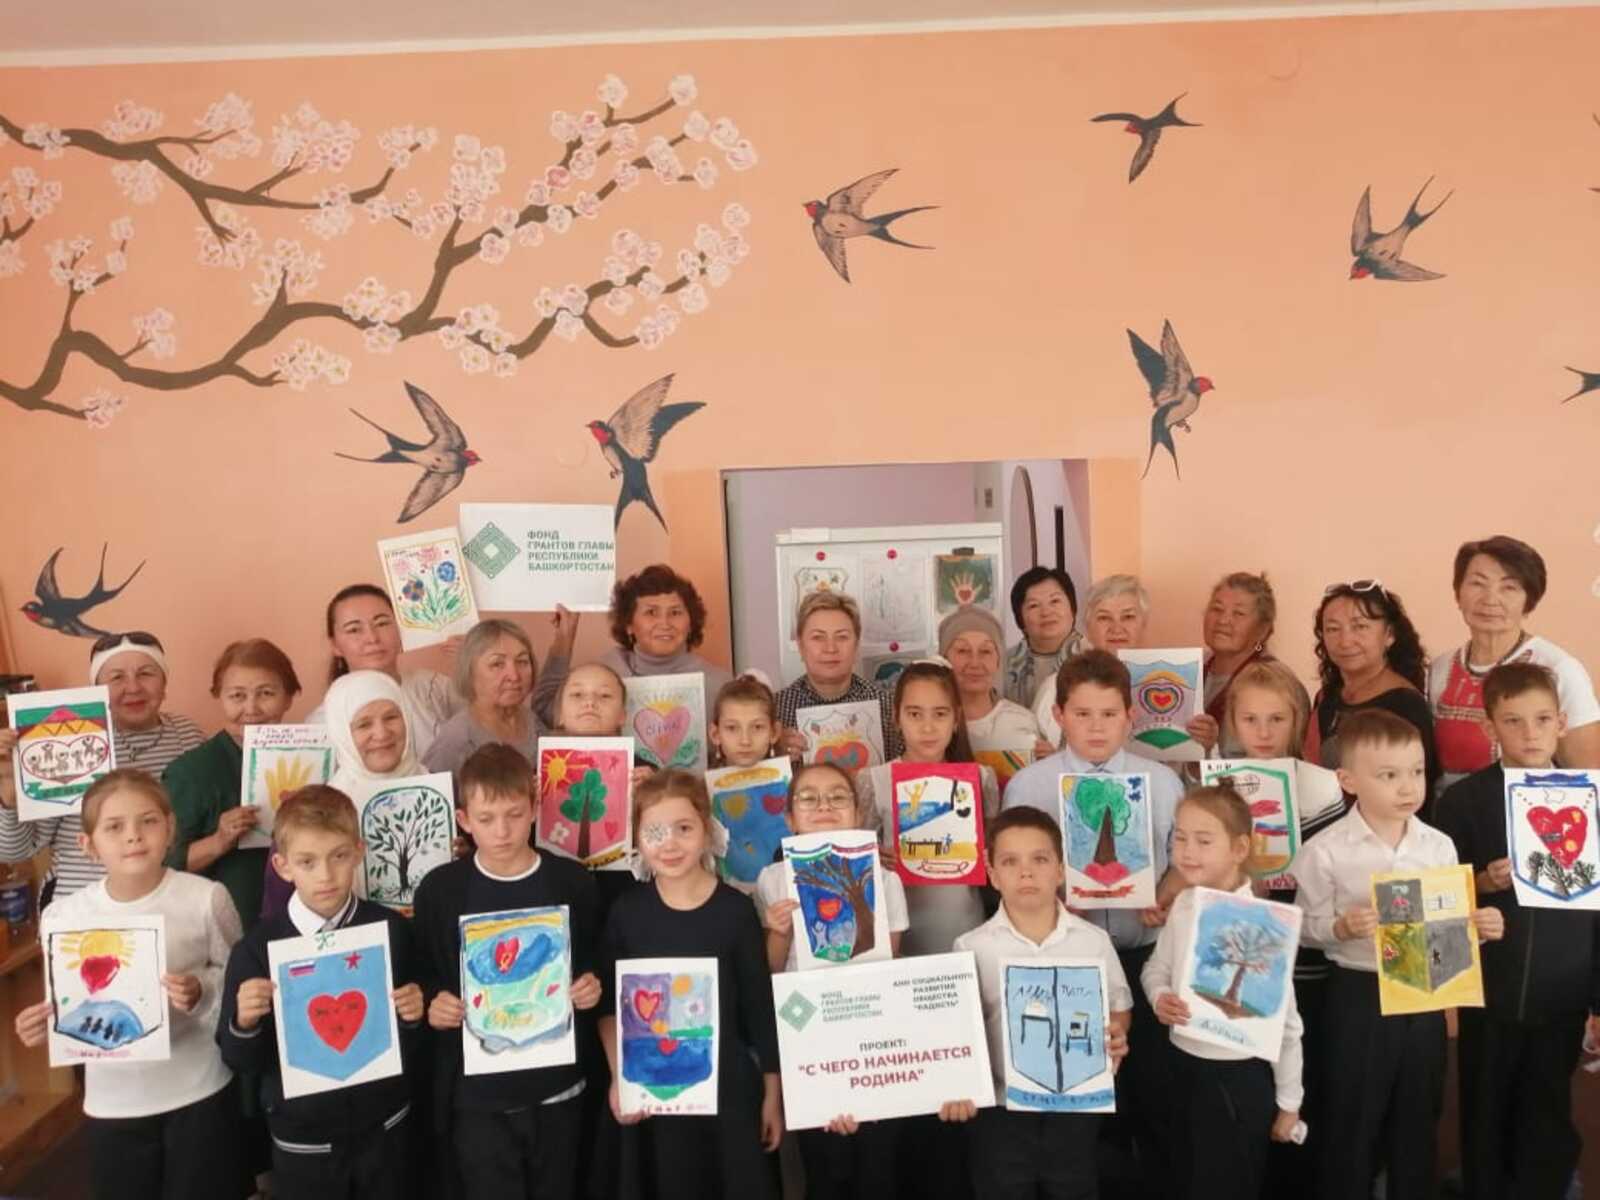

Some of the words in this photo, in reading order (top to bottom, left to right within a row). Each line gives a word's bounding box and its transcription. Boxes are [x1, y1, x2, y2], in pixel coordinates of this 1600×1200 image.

[527, 530, 560, 540] ФОНД
[527, 541, 575, 550] ГРАНТОВ
[578, 541, 615, 550] ГЛАВЫ
[528, 551, 599, 561] РЕСПУБЛИКИ
[528, 562, 615, 571] БАШКОРТОСТАН
[913, 983, 956, 993] РАЗВИТИЯ
[913, 992, 958, 1002] ОБЩЕСТВА
[859, 1038, 907, 1052] ПРОЕКТ:
[798, 1064, 816, 1076] "С
[820, 1058, 860, 1075] ЧЕГО
[864, 1045, 972, 1070] НАЧИНАЕТСЯ
[850, 1069, 925, 1089] РОДИНА"
